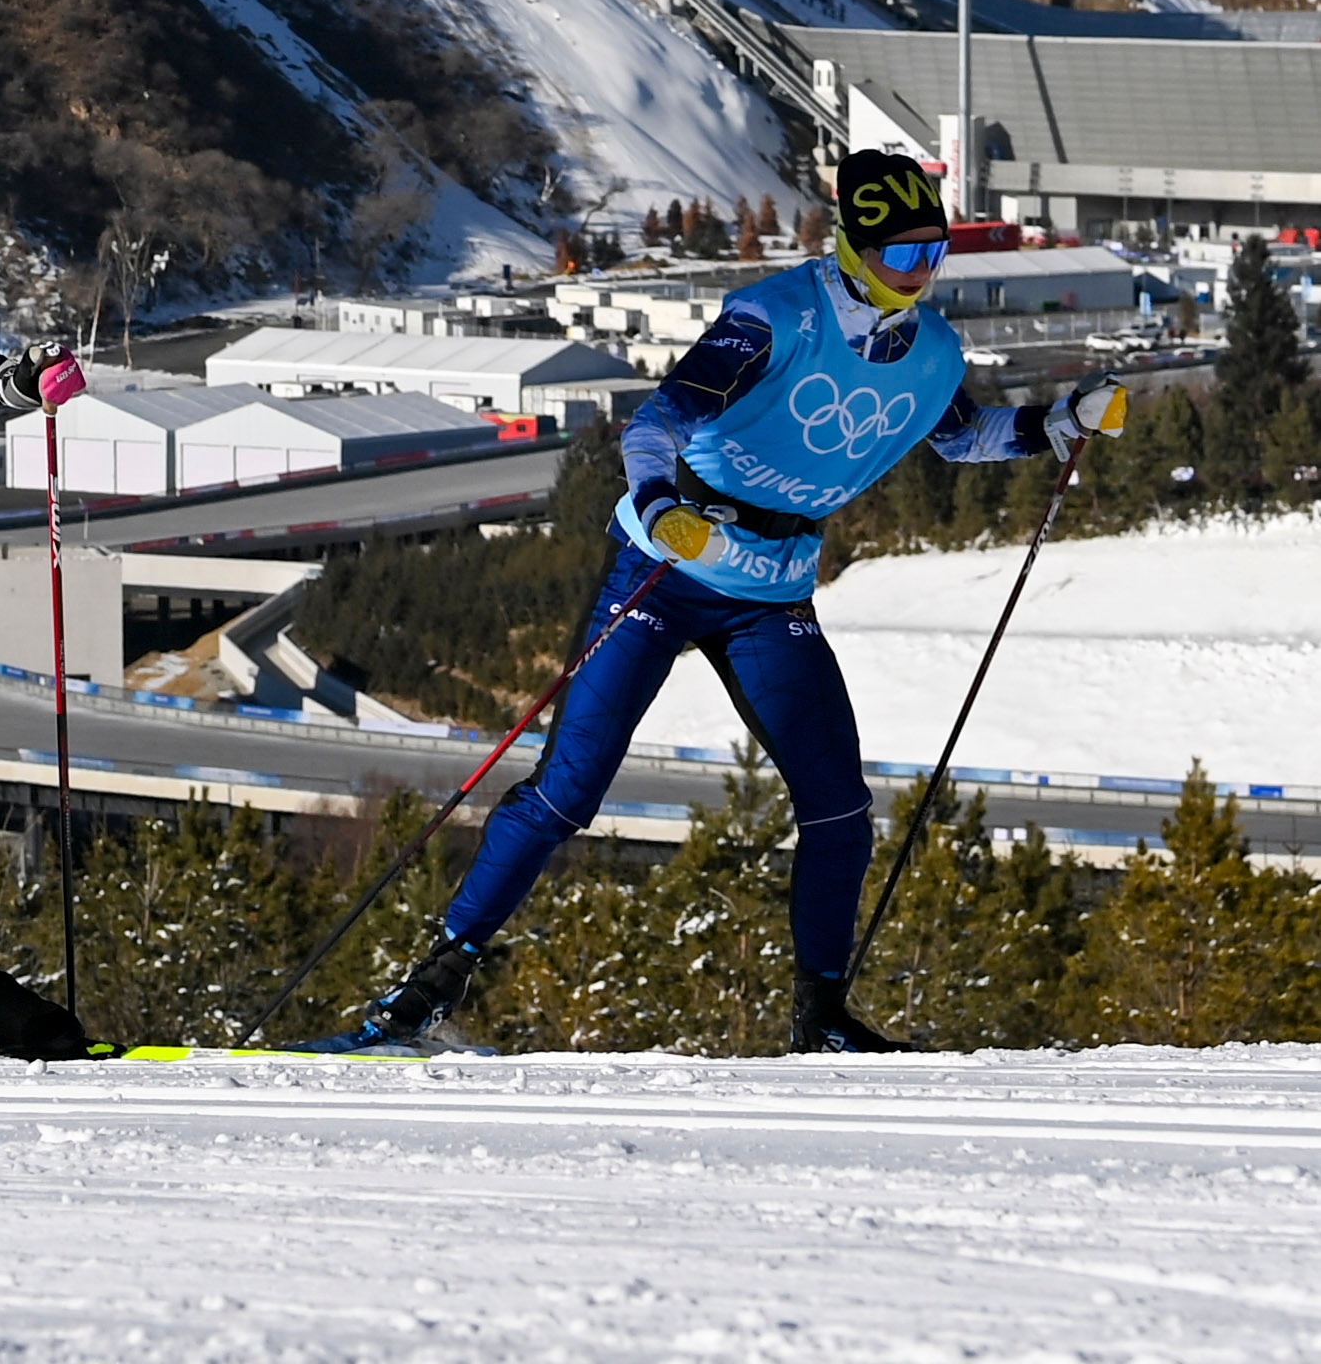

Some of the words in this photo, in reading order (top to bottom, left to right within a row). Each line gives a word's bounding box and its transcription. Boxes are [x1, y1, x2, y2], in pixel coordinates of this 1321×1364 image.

[852, 170, 941, 227] SW
[718, 438, 817, 504] BEIJING
[609, 603, 657, 626] CAFT
[788, 621, 821, 636] SW
